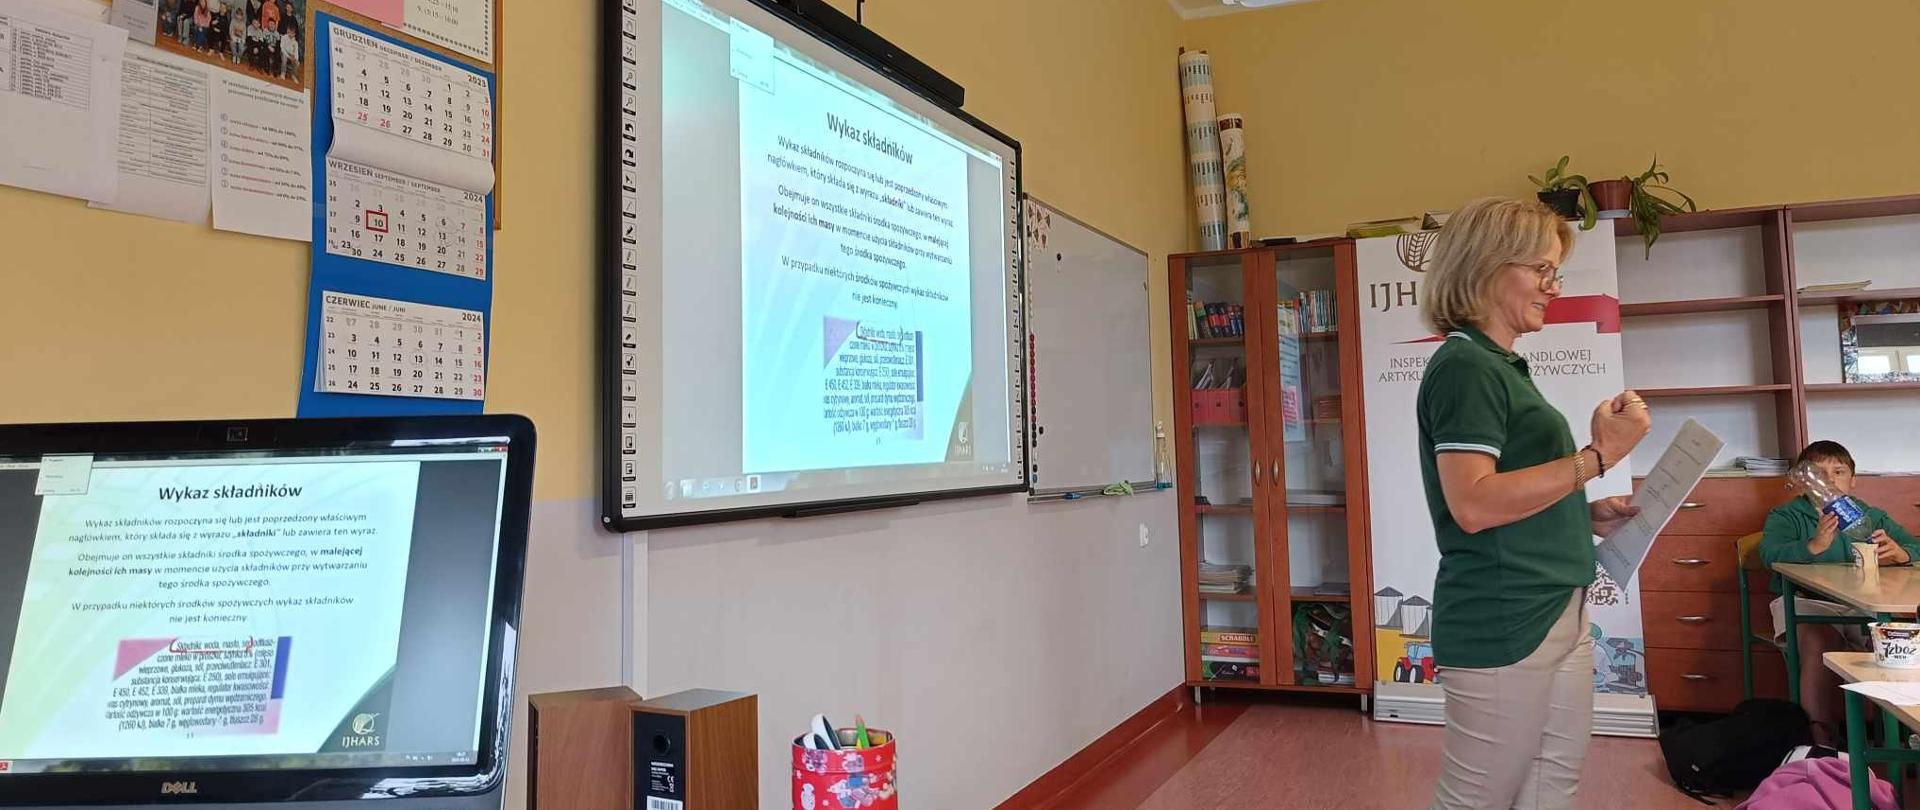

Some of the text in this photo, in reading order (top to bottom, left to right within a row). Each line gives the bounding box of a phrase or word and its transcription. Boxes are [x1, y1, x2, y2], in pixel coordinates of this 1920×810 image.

[467, 75, 486, 88] 2023
[360, 83, 368, 91] 11
[381, 90, 390, 98] 12
[403, 97, 412, 105] 13
[424, 103, 432, 112] 14
[445, 110, 452, 118] 15
[360, 98, 489, 144] 18 19 20 21 22 23 24
[358, 112, 368, 121] 25
[380, 119, 391, 127] 26
[403, 126, 412, 134] 27
[423, 132, 432, 140] 28
[443, 138, 452, 146] 29
[463, 143, 471, 152] 30
[826, 112, 913, 165] Wykaz składników
[375, 173, 405, 184] SEPTEMBER
[411, 182, 441, 193] SEPTEMBER
[464, 192, 483, 202] 2024
[773, 202, 835, 233] kolejności ich masy
[375, 219, 383, 227] 10
[398, 224, 405, 232] 11
[418, 228, 426, 236] 12
[351, 230, 360, 238] 16
[418, 242, 426, 250] 19
[437, 246, 446, 254] 20
[341, 240, 350, 248] 23
[352, 248, 361, 256] 30
[395, 253, 405, 261] 25
[416, 257, 426, 265] 26
[437, 261, 446, 269] 27
[456, 264, 465, 272] 28
[782, 255, 824, 276] W przypadku
[1370, 281, 1418, 312] IJH
[326, 296, 370, 309] CZERWIEC
[462, 313, 481, 322] 2024
[415, 355, 423, 363] 13
[1390, 349, 1591, 369] INSPEK ANDLOWEJ
[349, 365, 357, 373] 17
[371, 367, 379, 375] 18
[413, 370, 423, 378] 20
[435, 372, 442, 380] 21
[454, 373, 462, 381] 22
[1379, 363, 1606, 383] ARTYKU ŻYWCZYCH
[370, 382, 379, 390] 25
[414, 385, 423, 393] 27
[434, 386, 443, 394] 28
[159, 484, 302, 503] Wykaz składników
[85, 513, 367, 529] Wykaz składników rozpoczyna się lub jest poprzedzony właściwym
[68, 532, 122, 543] nagłówkiem,
[125, 531, 147, 542] który
[150, 530, 177, 540] składa
[179, 530, 190, 540] się
[199, 531, 232, 541] wyrazu
[283, 528, 296, 537] lub
[298, 528, 331, 536] zawiera
[334, 528, 348, 536] ten
[350, 528, 378, 537] wyraz.
[78, 552, 120, 563] Obejmuje
[135, 551, 176, 561] wszystkie
[178, 550, 216, 559] składniki
[218, 549, 247, 558] środka
[250, 549, 307, 559] spożywczego,
[320, 547, 363, 557] malejącej
[68, 567, 113, 578] kolejności
[114, 567, 127, 576] ich
[129, 567, 152, 577] masy
[164, 566, 209, 574] momencie
[241, 563, 289, 572] składników
[292, 563, 310, 573] przy
[312, 561, 368, 571] wytwarzaniu
[159, 580, 178, 590] tego
[181, 579, 211, 588] środka
[83, 602, 128, 612] przypadku
[130, 600, 176, 610] niektórych
[178, 599, 215, 609] środków
[218, 598, 274, 608] spożywczych
[276, 599, 303, 607] wykaz
[305, 596, 354, 605] składników
[169, 615, 183, 623] nie
[185, 614, 201, 624] jest
[342, 736, 380, 748] IJHARS
[161, 781, 197, 794] DELL
